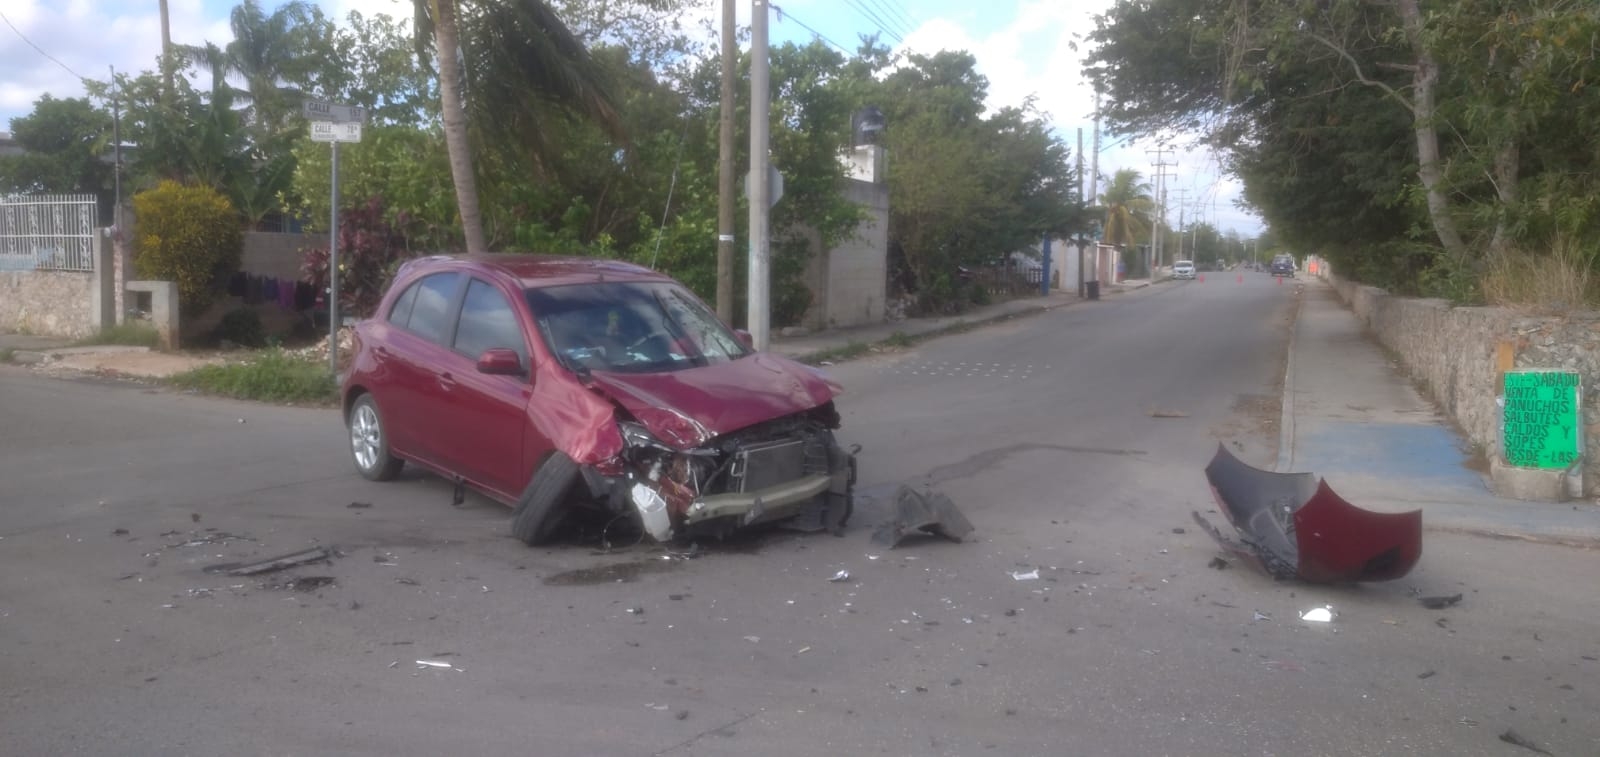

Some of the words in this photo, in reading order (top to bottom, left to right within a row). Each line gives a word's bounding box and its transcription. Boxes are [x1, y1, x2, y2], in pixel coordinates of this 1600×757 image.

[309, 102, 330, 113] CALLE
[314, 124, 332, 134] CALLE
[1504, 386, 1538, 399] VENTA
[1553, 387, 1569, 401] DE
[1504, 399, 1569, 414] PANUCHOS
[1504, 410, 1561, 425] SALBUTES
[1504, 423, 1550, 438] CALDOS
[1562, 425, 1572, 440] Y
[1505, 448, 1540, 462] DESDE
